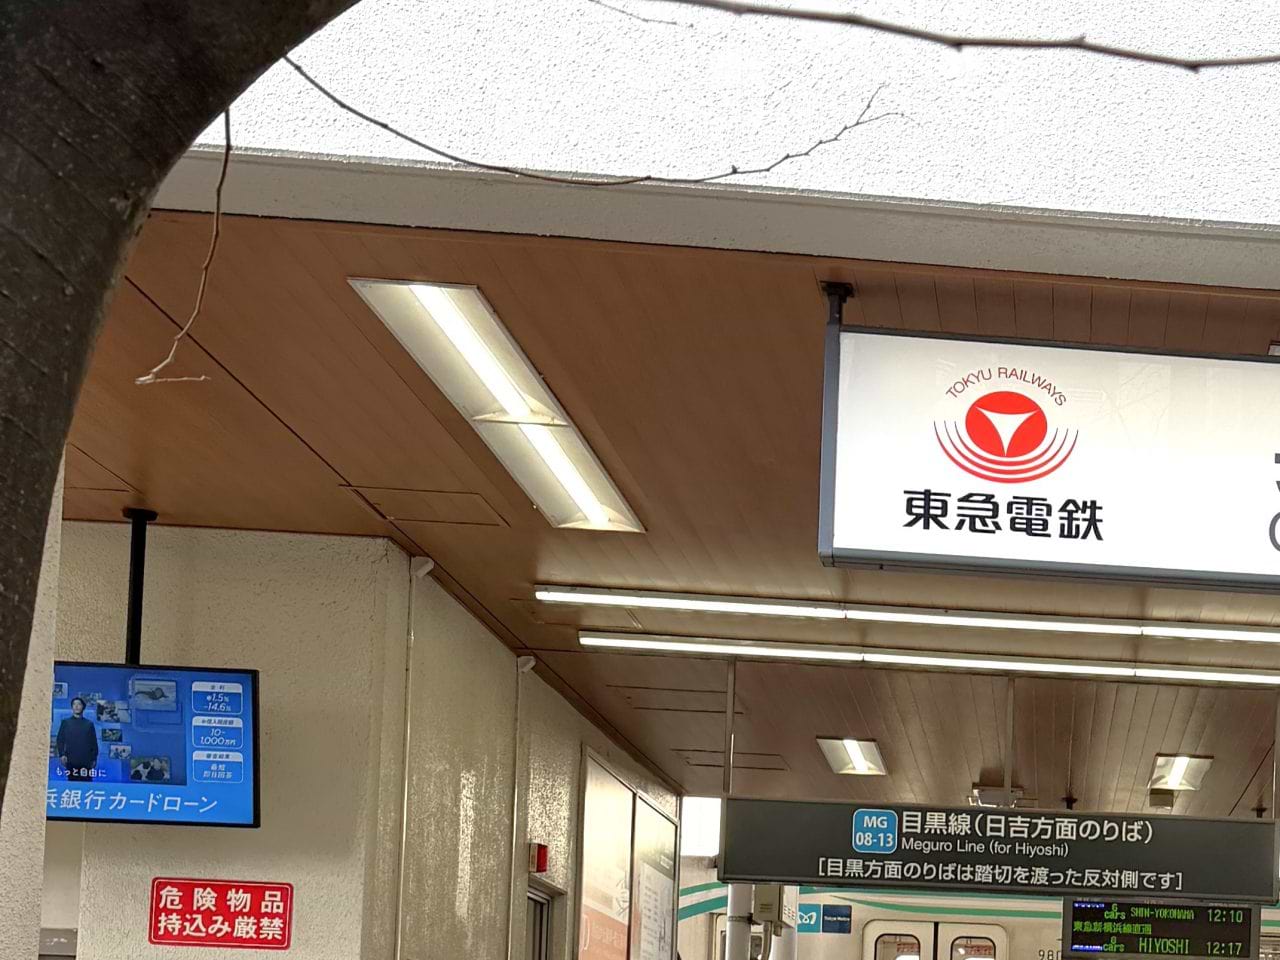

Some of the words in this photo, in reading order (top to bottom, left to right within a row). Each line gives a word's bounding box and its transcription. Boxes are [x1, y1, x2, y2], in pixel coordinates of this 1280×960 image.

[945, 367, 993, 400] TOKYU
[997, 366, 1067, 407] RAILWAYS
[902, 489, 1104, 541] 東急電鉄
[863, 815, 888, 829] MG
[902, 811, 1154, 844] 目黒線(日吉方面のりば)
[856, 832, 893, 848] 08-13
[901, 837, 953, 853] Meguro
[957, 839, 985, 853] Line
[989, 839, 1012, 855] (for
[1015, 841, 1069, 858] Hiyoshi)
[159, 885, 284, 914] 危険物品
[158, 912, 284, 940] 持込み厳禁
[1104, 911, 1126, 920] cars
[1130, 907, 1195, 920] SHIN-YOKOHAMA
[1207, 908, 1243, 923] 12:10
[1138, 937, 1190, 954] HIYOSHI
[1206, 941, 1243, 956] 12:17
